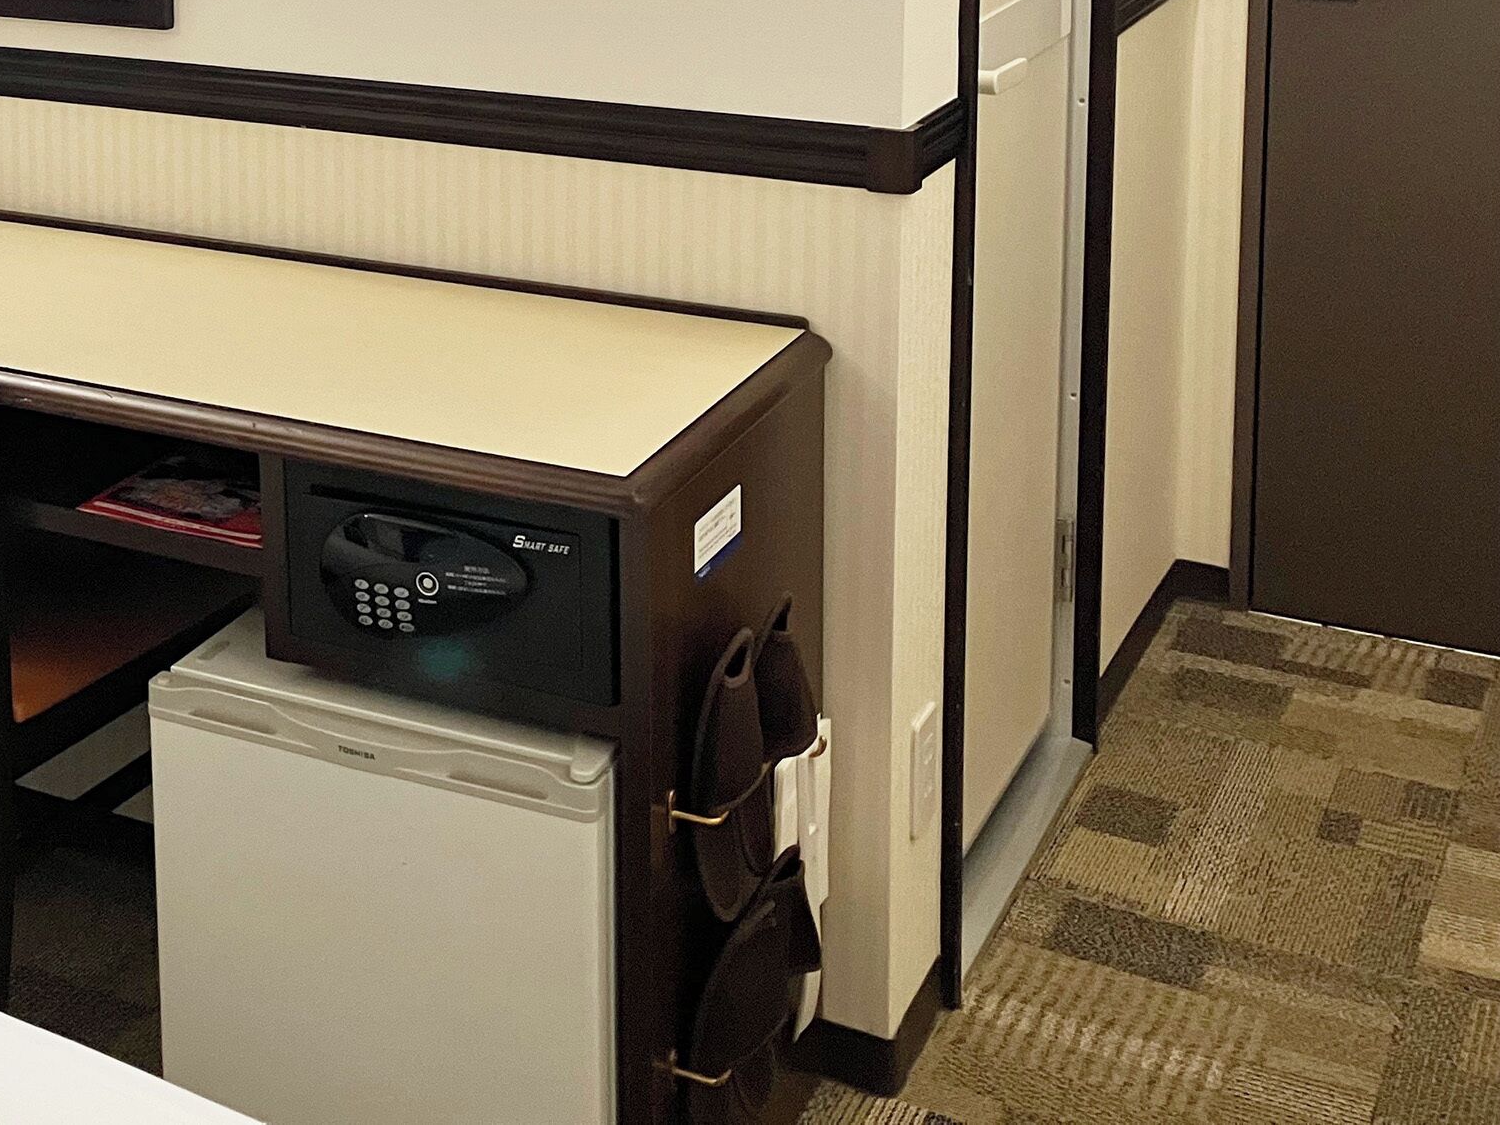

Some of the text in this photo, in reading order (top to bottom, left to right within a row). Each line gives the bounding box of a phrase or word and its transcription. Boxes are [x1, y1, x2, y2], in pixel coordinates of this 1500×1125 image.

[513, 534, 570, 555] SMART SAFE
[338, 744, 375, 760] TOSHIBA
